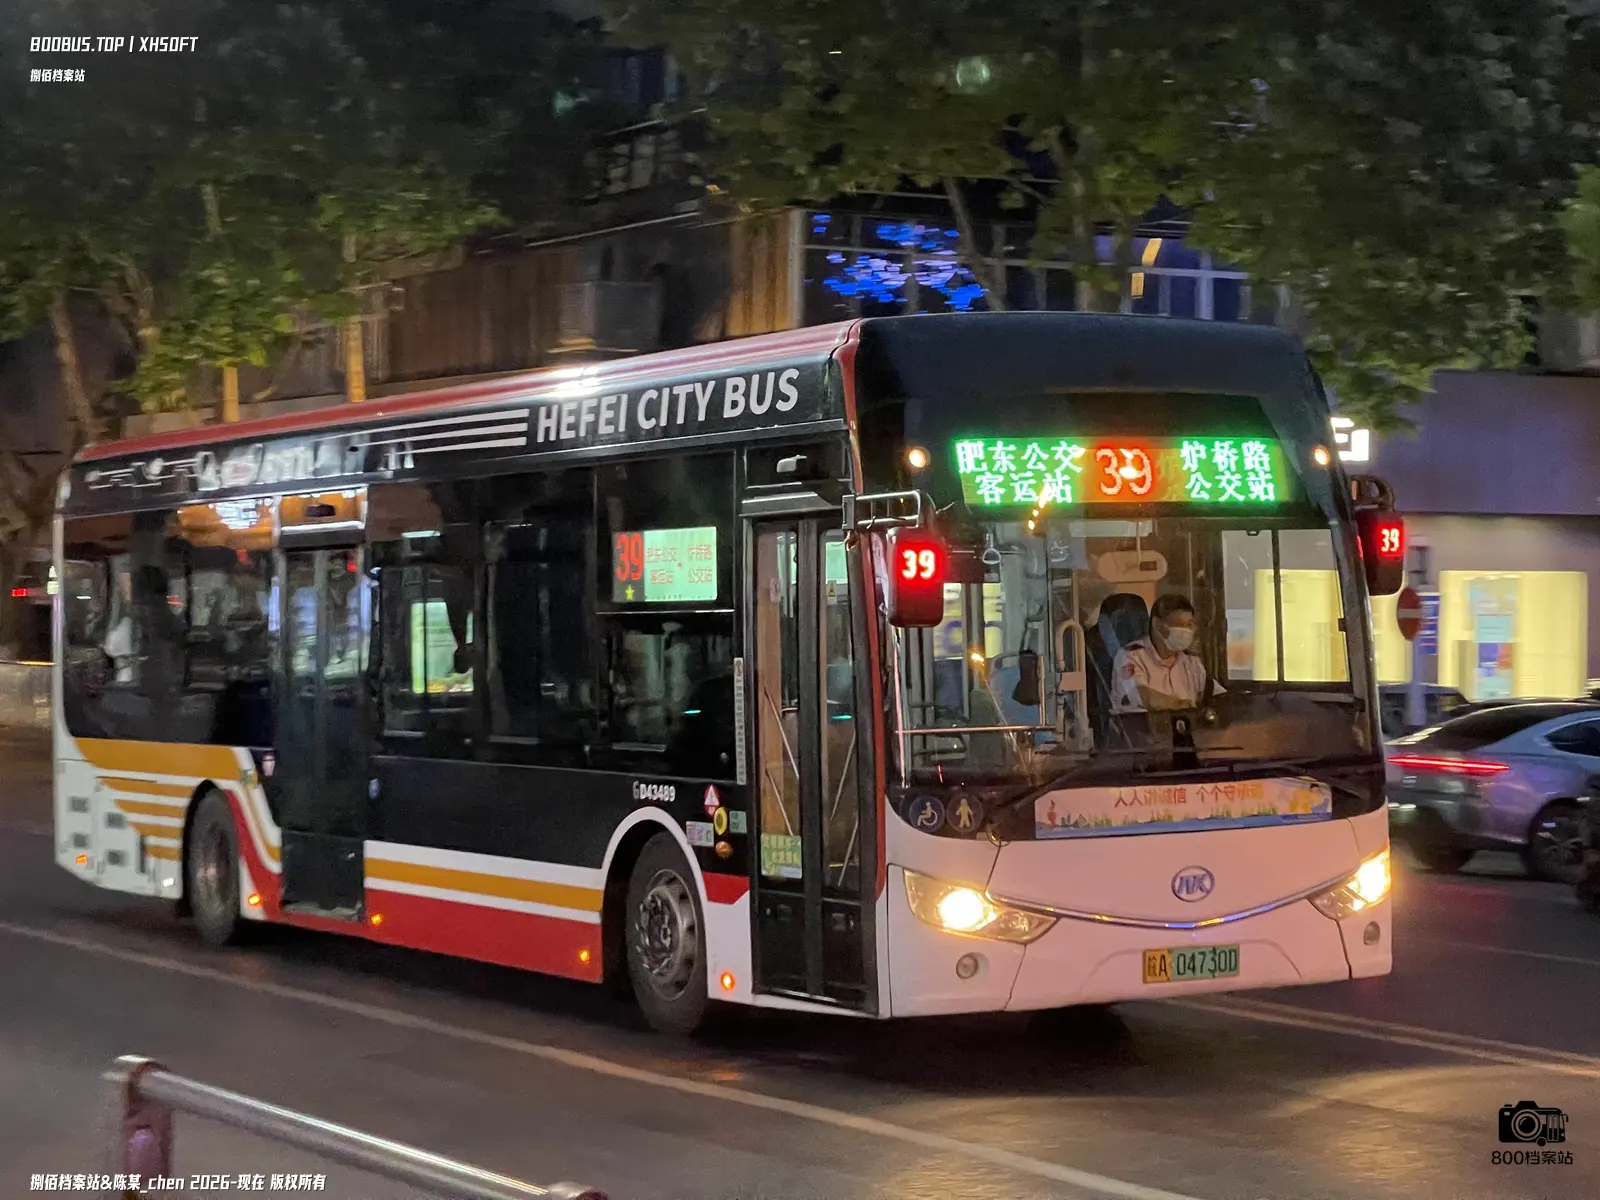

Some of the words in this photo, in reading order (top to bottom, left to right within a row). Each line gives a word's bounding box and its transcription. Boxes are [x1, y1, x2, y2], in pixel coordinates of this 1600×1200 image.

[536, 394, 628, 443] HEFEI
[637, 380, 715, 430] CITY
[723, 368, 800, 419] BUS
[956, 440, 1084, 473] 肥东公交
[1095, 447, 1153, 495] 39
[1180, 440, 1271, 473] 炉桥路
[975, 471, 1073, 504] 客运站
[1185, 470, 1276, 502] 公交站
[1381, 528, 1400, 552] 39
[615, 533, 643, 582] 39
[902, 549, 936, 579] 39
